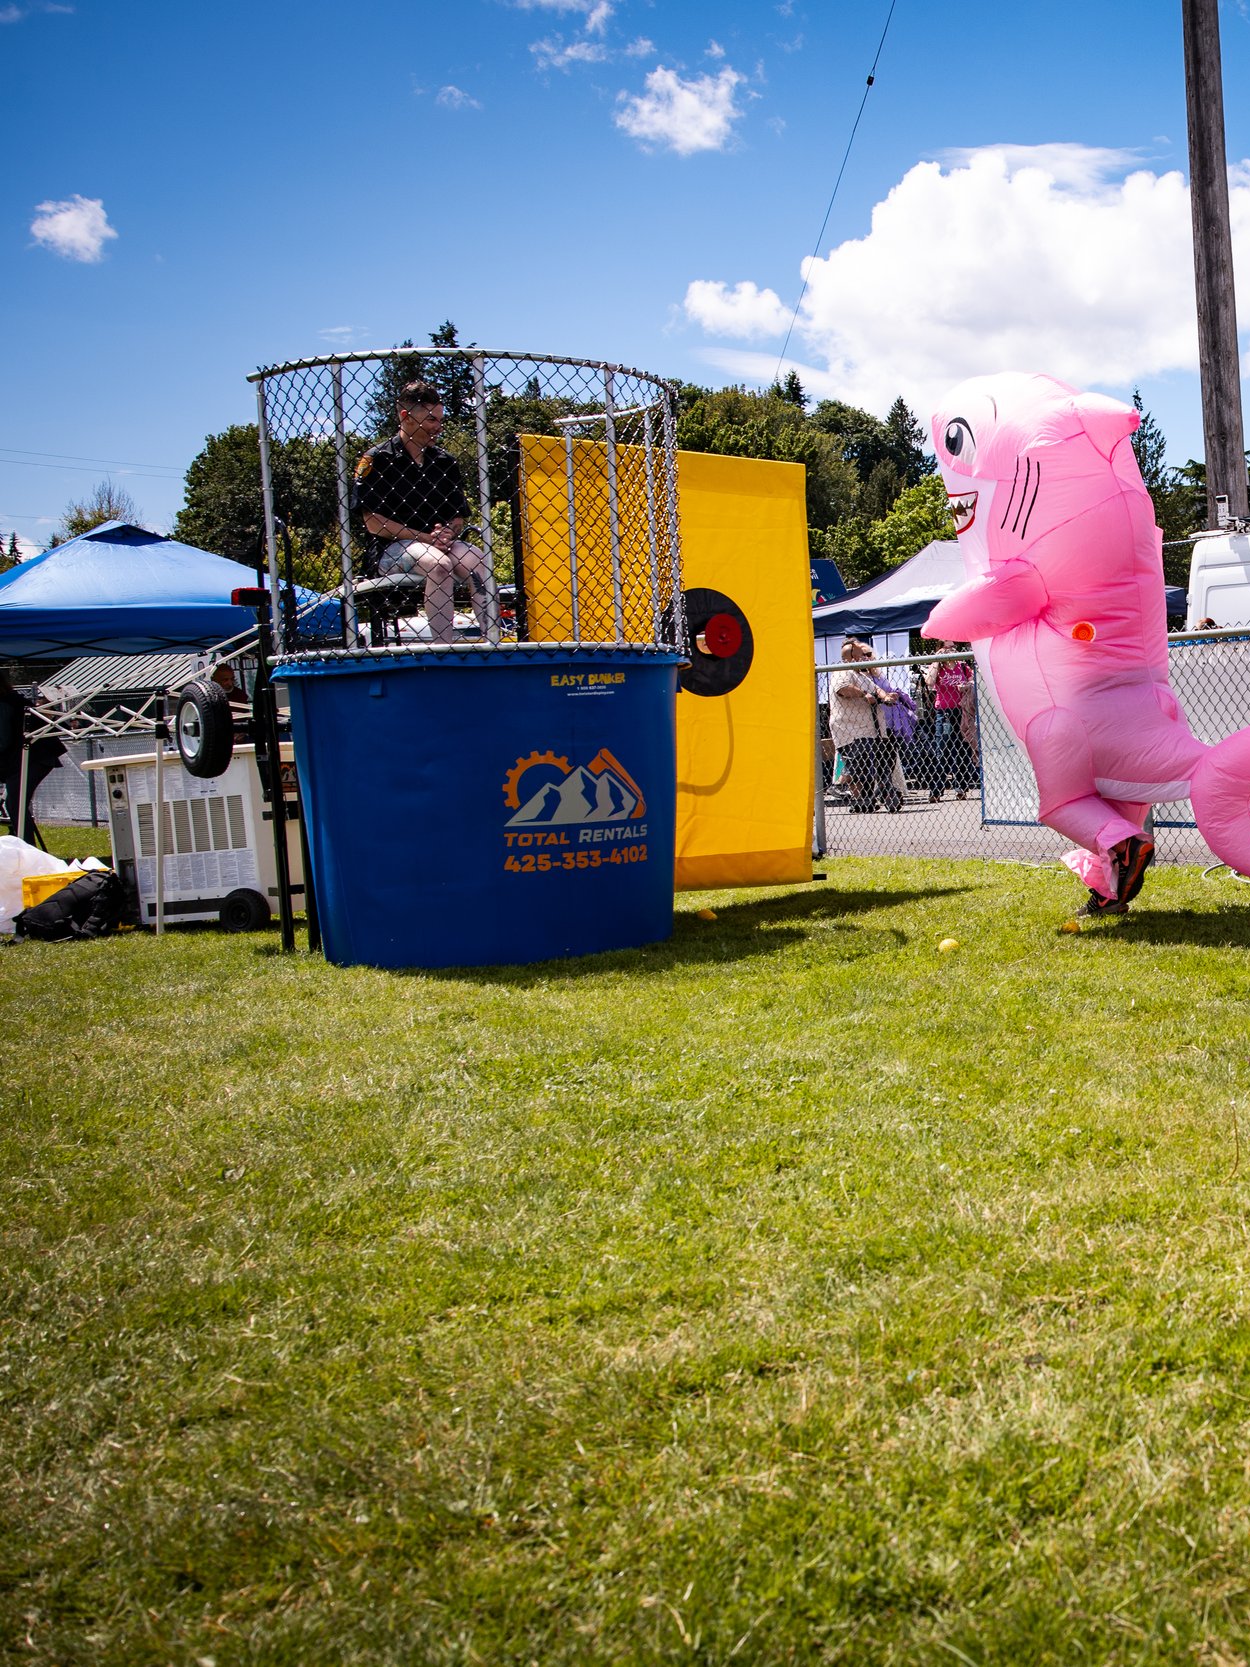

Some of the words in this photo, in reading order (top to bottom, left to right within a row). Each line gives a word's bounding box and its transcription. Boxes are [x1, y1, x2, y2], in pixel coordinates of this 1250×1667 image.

[550, 674, 585, 687] EASY
[504, 832, 570, 847] TOTAL
[578, 824, 648, 843] RENTALS
[504, 844, 648, 873] 425-353-4102
